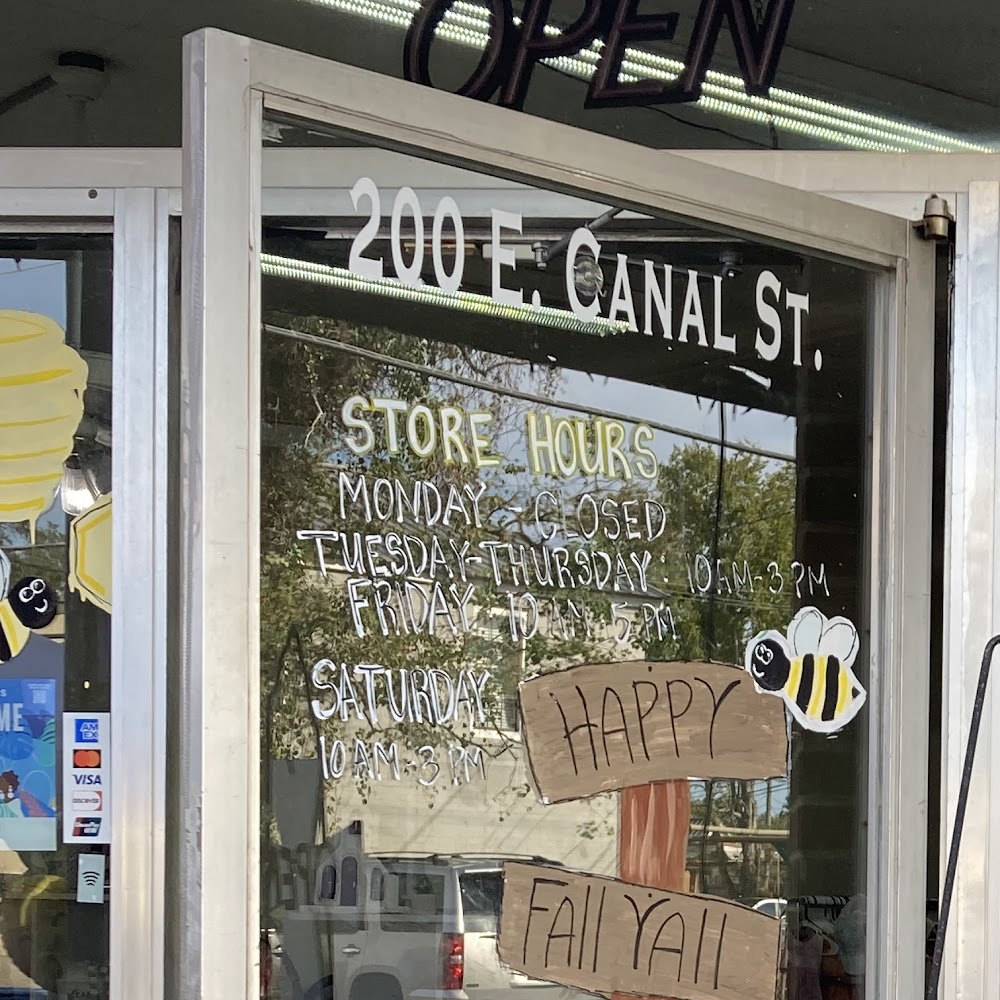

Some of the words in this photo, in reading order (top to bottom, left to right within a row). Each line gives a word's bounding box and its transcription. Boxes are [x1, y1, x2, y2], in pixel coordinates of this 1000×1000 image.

[402, 0, 794, 110] OPEN
[348, 176, 464, 295] 200
[490, 208, 542, 308] E.
[566, 227, 736, 355] CANAL
[754, 269, 823, 372] ST.
[341, 396, 500, 468] STORE
[526, 410, 659, 480] HOURS
[338, 471, 487, 528] MONDAY
[535, 490, 668, 542] CLOSED
[348, 578, 476, 639] FRIDAY
[311, 658, 491, 725] SATURDAY
[549, 676, 742, 776] HAPPY
[72, 774, 102, 785] VISA
